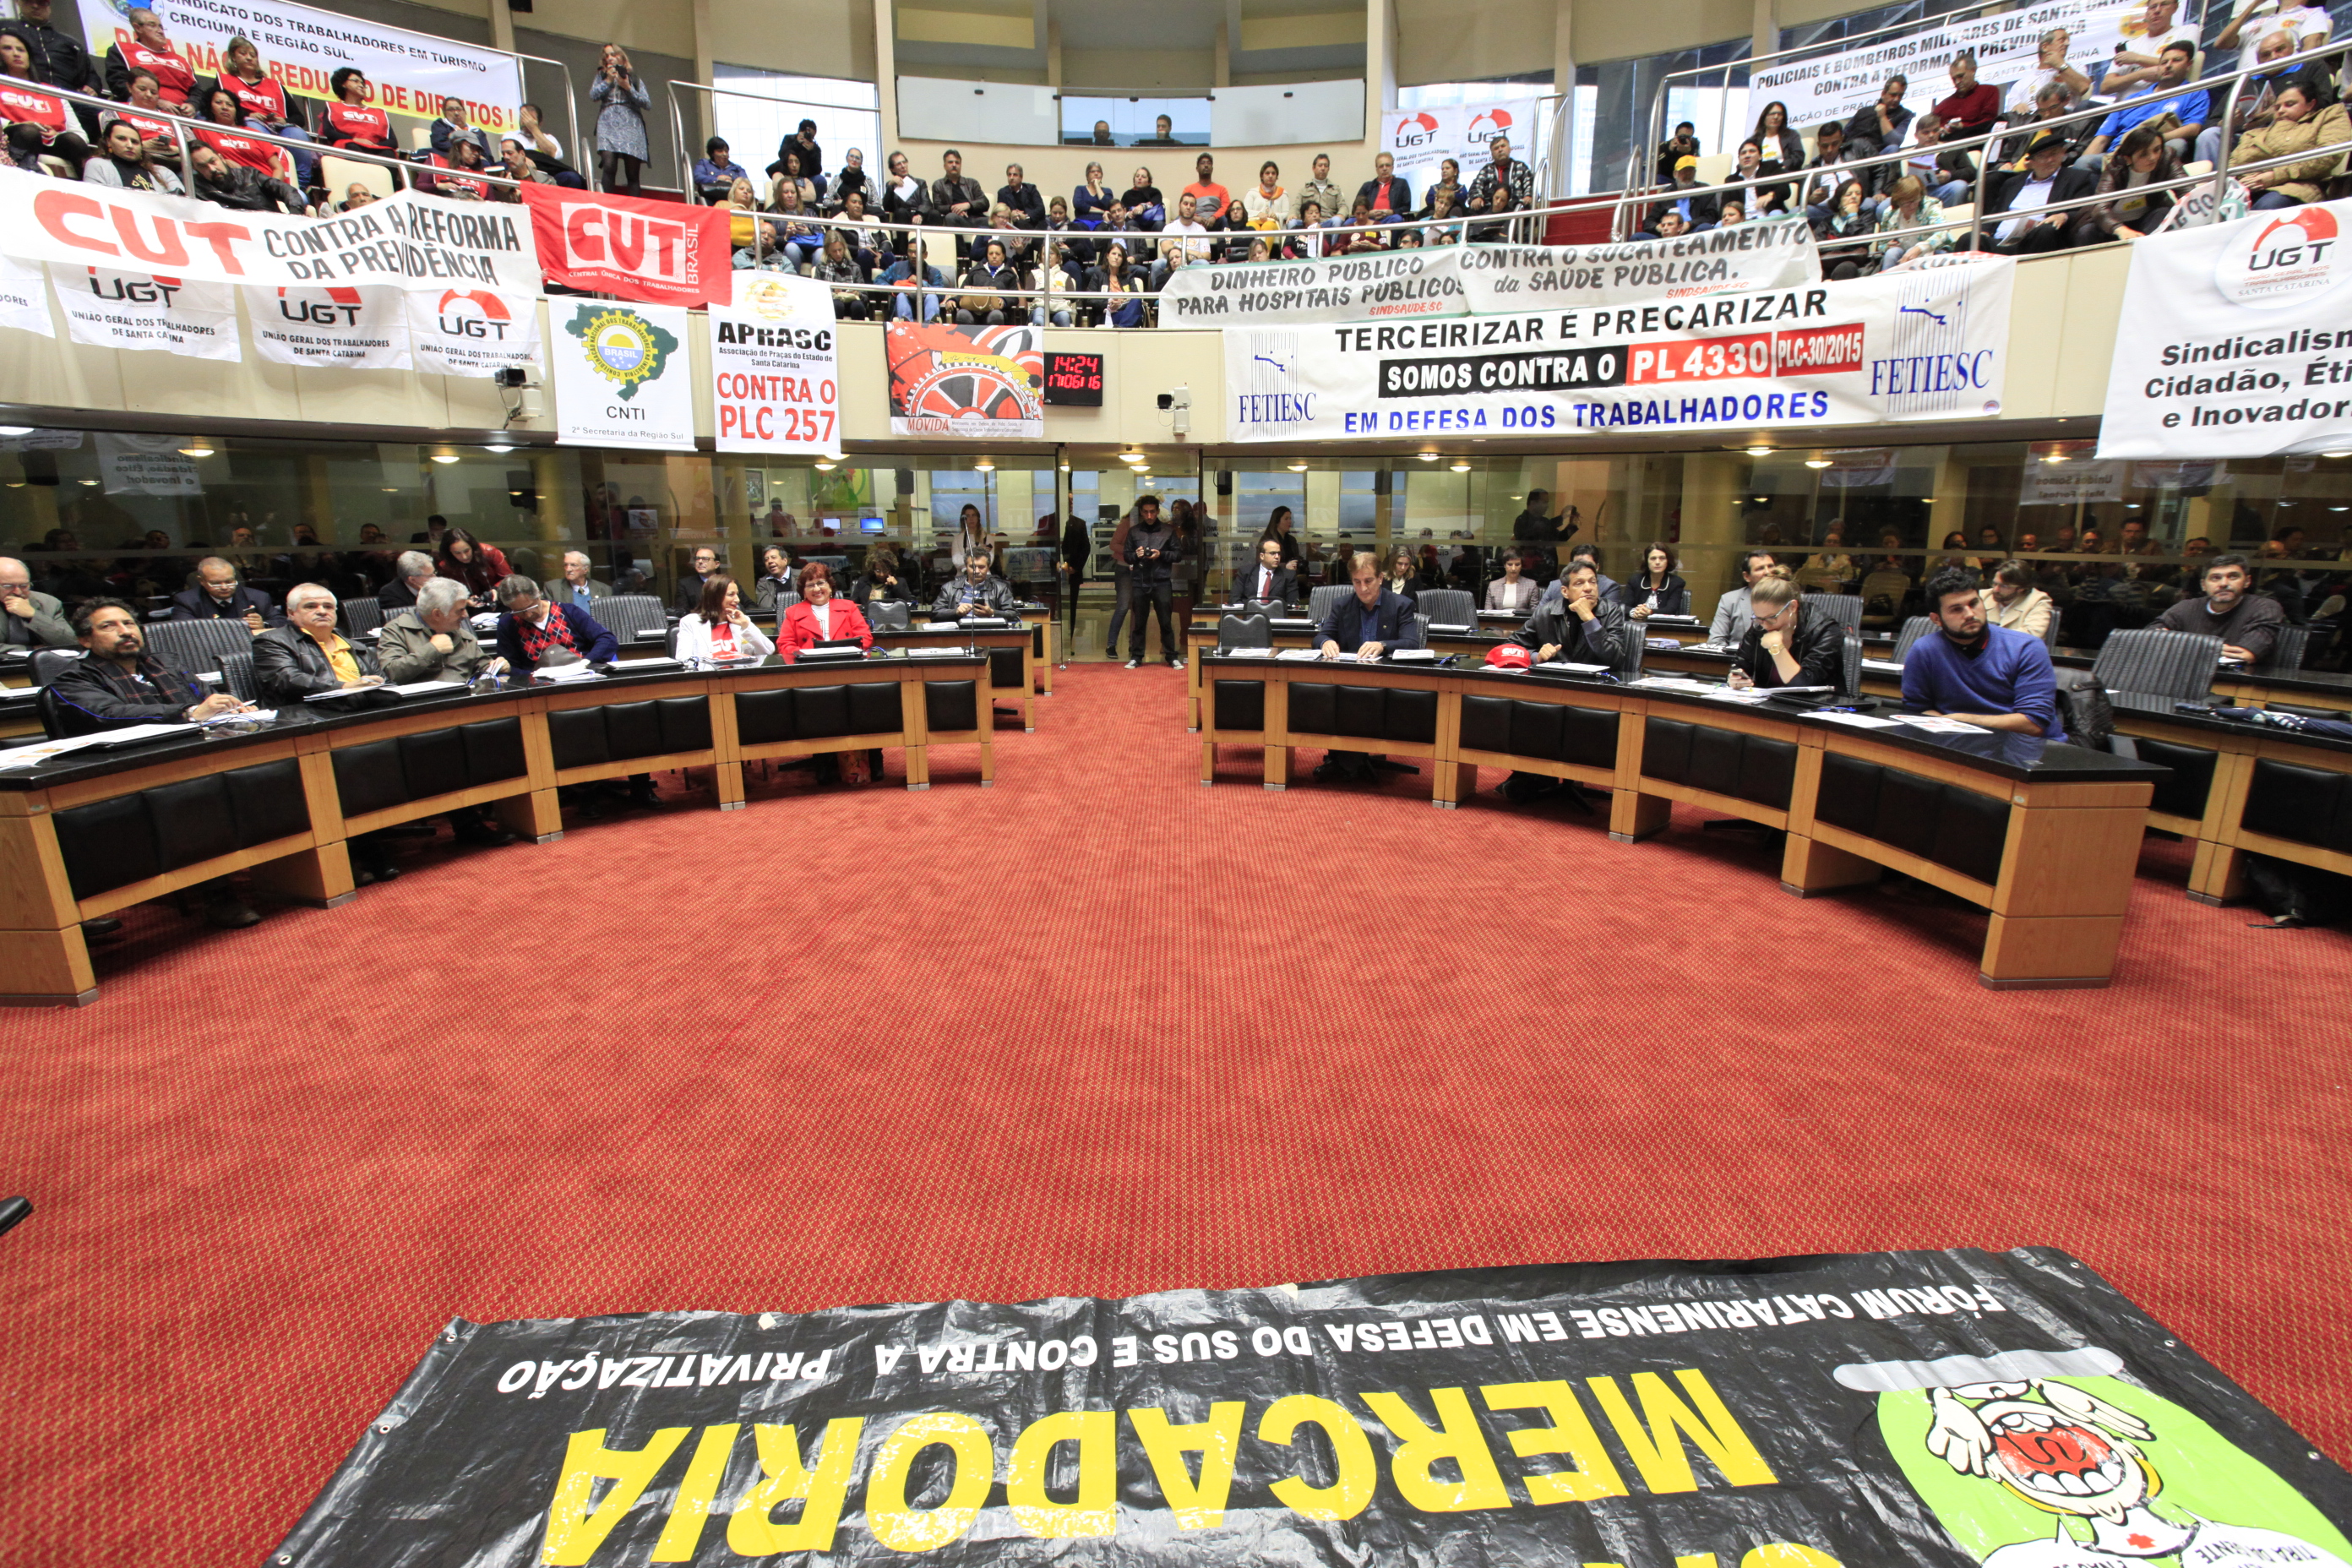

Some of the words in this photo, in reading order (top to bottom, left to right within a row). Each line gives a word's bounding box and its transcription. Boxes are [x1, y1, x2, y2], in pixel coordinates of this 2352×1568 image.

[169, 11, 247, 38] CRICIÚMA
[252, 30, 261, 41] E
[265, 32, 319, 53] REGIÃO
[324, 45, 355, 62] SUL.
[253, 11, 283, 28] DOS
[286, 19, 406, 54] TRABALHADORES
[408, 47, 428, 60] EM
[431, 52, 487, 73] TURISMO
[1756, 64, 1821, 90] POLICIAIS
[1823, 60, 1832, 75] E
[1833, 41, 1917, 73] BOMBEIROS
[1919, 20, 2000, 54] MILITARES
[2002, 15, 2025, 34] DE
[2027, 1, 2082, 25] SANTA
[269, 60, 374, 103] REDUO
[382, 83, 409, 111] DE
[1814, 72, 1868, 97] CONTRA
[1883, 52, 1952, 83] REFORMA
[1825, 106, 1839, 117] DE
[1396, 129, 1439, 149] UGT
[34, 189, 252, 275] CUT
[264, 214, 384, 258] CONTRA
[385, 204, 406, 236] A
[406, 201, 521, 252] REFORMA
[567, 207, 684, 278] CUT
[287, 258, 337, 280] DA
[338, 240, 500, 286] PREVIDÊNCIA
[686, 223, 699, 285] BRASIL
[1460, 245, 1554, 270] CONTRA
[1562, 246, 1578, 264] O
[1585, 225, 1808, 264] SUCATEAMENTO
[2248, 241, 2336, 271] UGT
[569, 270, 598, 278] CENTRAL
[602, 270, 621, 280] ÚNICA
[642, 280, 700, 294] TRABALHADORES
[1211, 266, 1316, 291] DINHEIRO
[1328, 256, 1424, 286] PÚBLICO
[1494, 275, 1520, 294] da
[1527, 264, 1604, 292] SAÚDE
[1614, 258, 1739, 287] PÚBLICA.
[2238, 286, 2272, 297] SANTA
[2274, 278, 2331, 292] CATARINA
[88, 277, 182, 308] UGT
[1177, 293, 1229, 315] PARA
[1239, 286, 1352, 313] HOSPITAIS
[1369, 301, 1443, 316] SINDSAÚDE/SC
[71, 310, 102, 323] UNIÃO
[105, 315, 133, 326] GERAL
[136, 318, 155, 327] DOS
[280, 299, 362, 328] UGT
[438, 315, 511, 341] UGT
[1335, 317, 1544, 352] TERCEIRIZAR
[1560, 308, 1577, 339] É
[1593, 289, 1827, 337] PRECARIZAR
[112, 328, 124, 336] DE
[125, 329, 155, 339] SANTA
[262, 330, 287, 342] UNIÃO
[289, 335, 314, 346] GERAL
[316, 337, 331, 346] DOS
[333, 338, 390, 348] TRABALHADORES
[591, 321, 606, 343] NACIONAL
[618, 318, 651, 353] TRABALHADORES
[717, 321, 831, 351] APRASC
[1778, 331, 1862, 368] PLC-30/2015
[293, 346, 304, 355] DE
[306, 349, 331, 357] SANTA
[332, 350, 367, 358] CATARINA
[420, 344, 444, 353] UNIÃO
[445, 347, 466, 357] GERAL
[468, 350, 481, 358] DOS
[459, 360, 479, 368] SANTA
[604, 347, 639, 358] BRASIL
[719, 346, 758, 357] Associação
[769, 350, 792, 359] Praças
[803, 353, 824, 362] Estado
[751, 358, 770, 367] Santa
[771, 360, 800, 369] Catarina
[1054, 356, 1098, 373] 14:24
[1633, 349, 1676, 382] PL
[1683, 340, 1769, 378] 4330
[1387, 363, 1473, 391] SOMOS
[1480, 355, 1589, 388] CONTRA
[1597, 353, 1616, 381] O
[1870, 349, 1994, 396] FETIESC
[2144, 368, 2292, 399] Cidadão,
[717, 372, 814, 403] CONTRA
[819, 378, 836, 405] O
[606, 406, 645, 421] CNTI
[1238, 392, 1317, 423] FETIESC
[1344, 411, 1378, 434] EM
[1389, 408, 1488, 433] DEFESA
[1503, 405, 1556, 428] DOS
[1573, 390, 1828, 427] TRABALHADORES
[2162, 411, 2182, 429] e
[582, 427, 625, 437] Secretaria
[628, 428, 638, 437] da
[640, 430, 668, 440] Região
[720, 405, 774, 440] PLC
[784, 407, 836, 443] 257
[906, 417, 950, 432] MOVIDA
[1569, 1293, 1855, 1339] CATARINENSE
[1851, 1284, 2006, 1320] FÓRUM
[1251, 1326, 1313, 1357] DO
[1325, 1315, 1494, 1352] DEFESA
[1497, 1311, 1569, 1343] EM
[874, 1344, 906, 1375] A
[917, 1335, 1098, 1374] CONTRA
[1113, 1335, 1138, 1368] E
[1152, 1330, 1239, 1364] SUS
[497, 1349, 832, 1399] PRIVATIZAÇÃO
[541, 1368, 1779, 1567] MERCADORIA
[2275, 1544, 2318, 1561] TIRA
